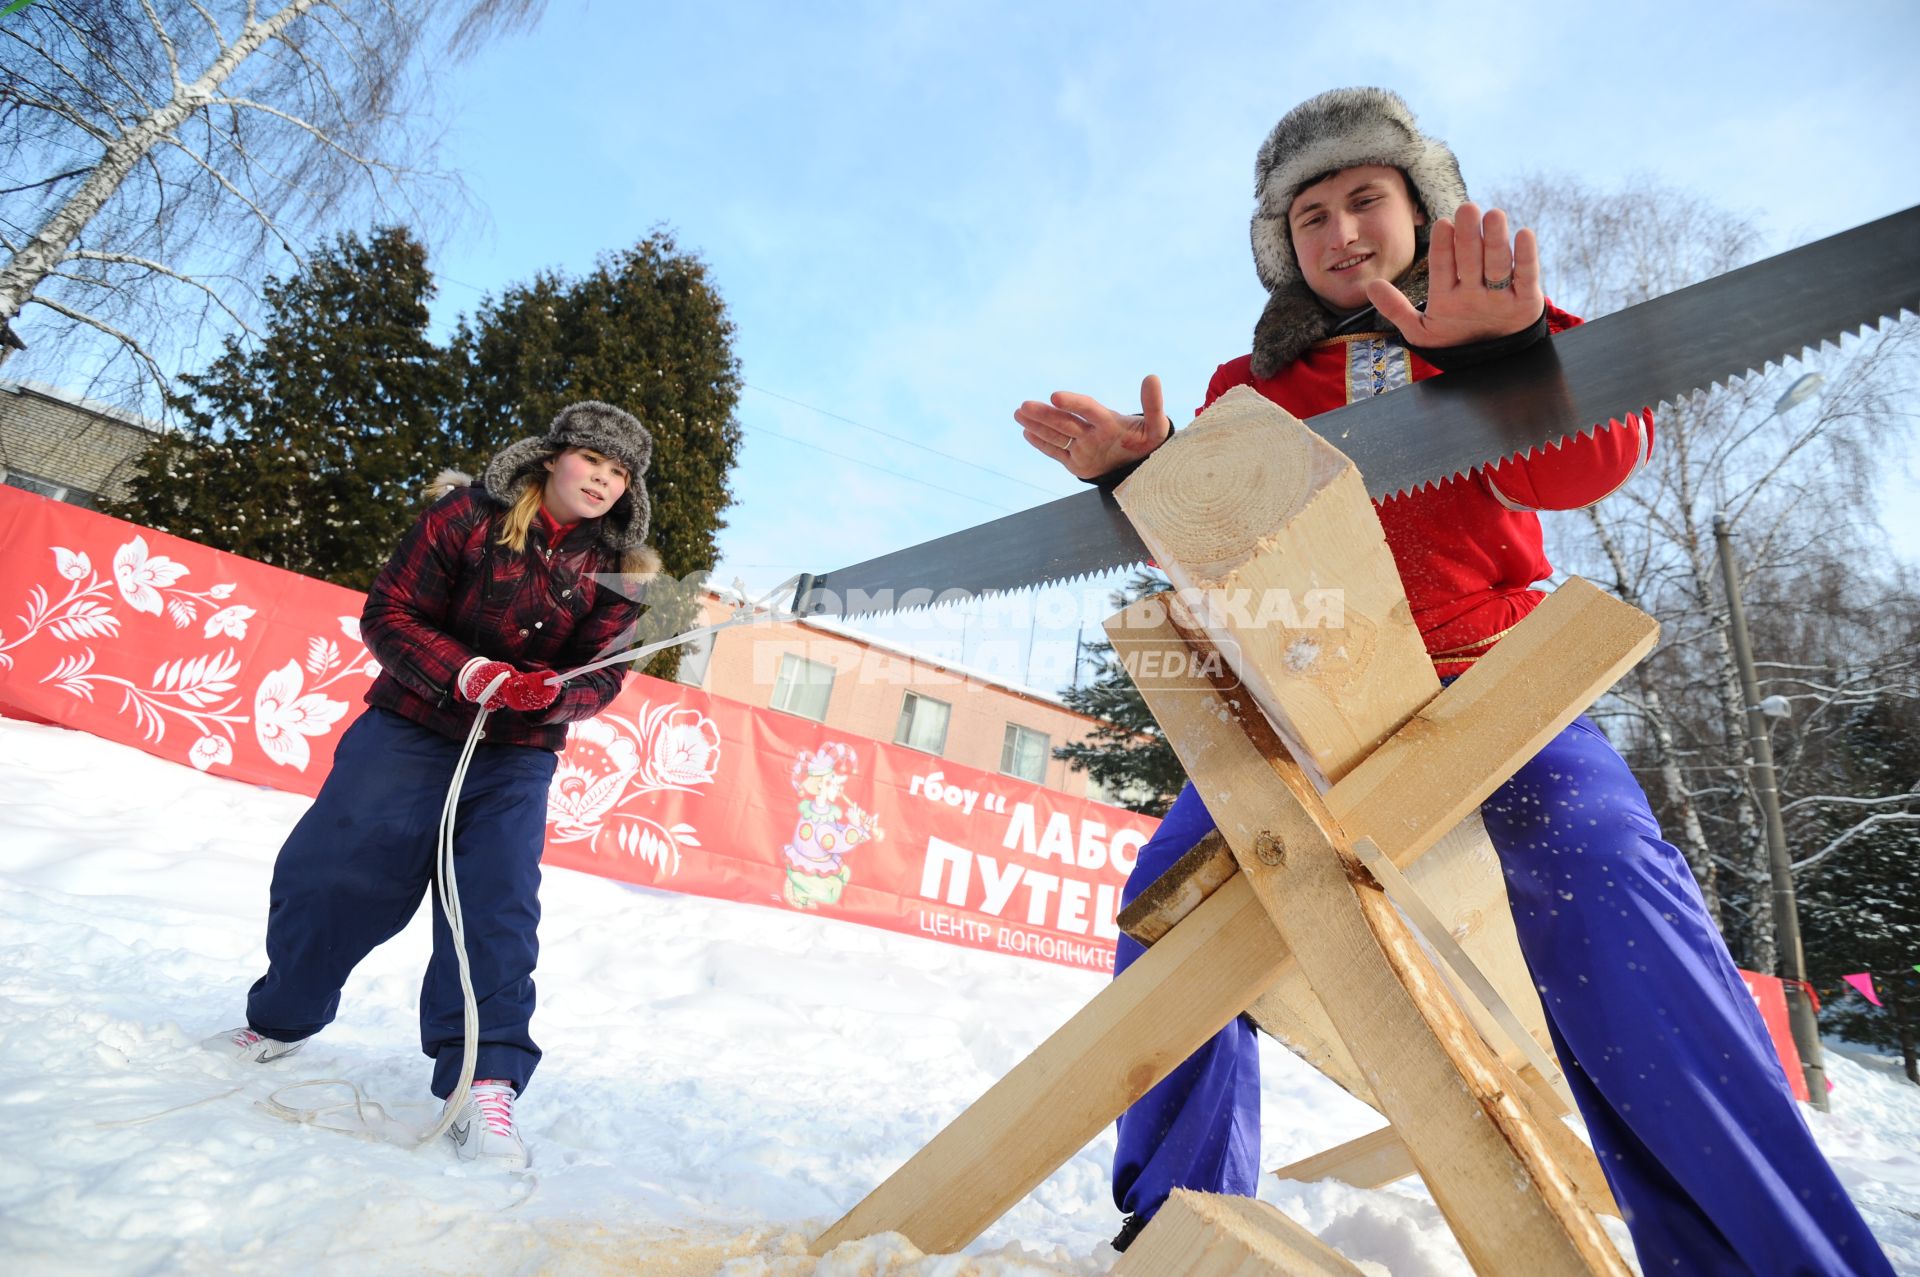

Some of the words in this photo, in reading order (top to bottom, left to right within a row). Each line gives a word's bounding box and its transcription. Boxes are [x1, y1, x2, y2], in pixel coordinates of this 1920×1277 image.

[909, 771, 980, 816] гбоу
[920, 910, 992, 943] ЦЕНТР
[997, 926, 1116, 970] ДОПОЛНИТЕ
